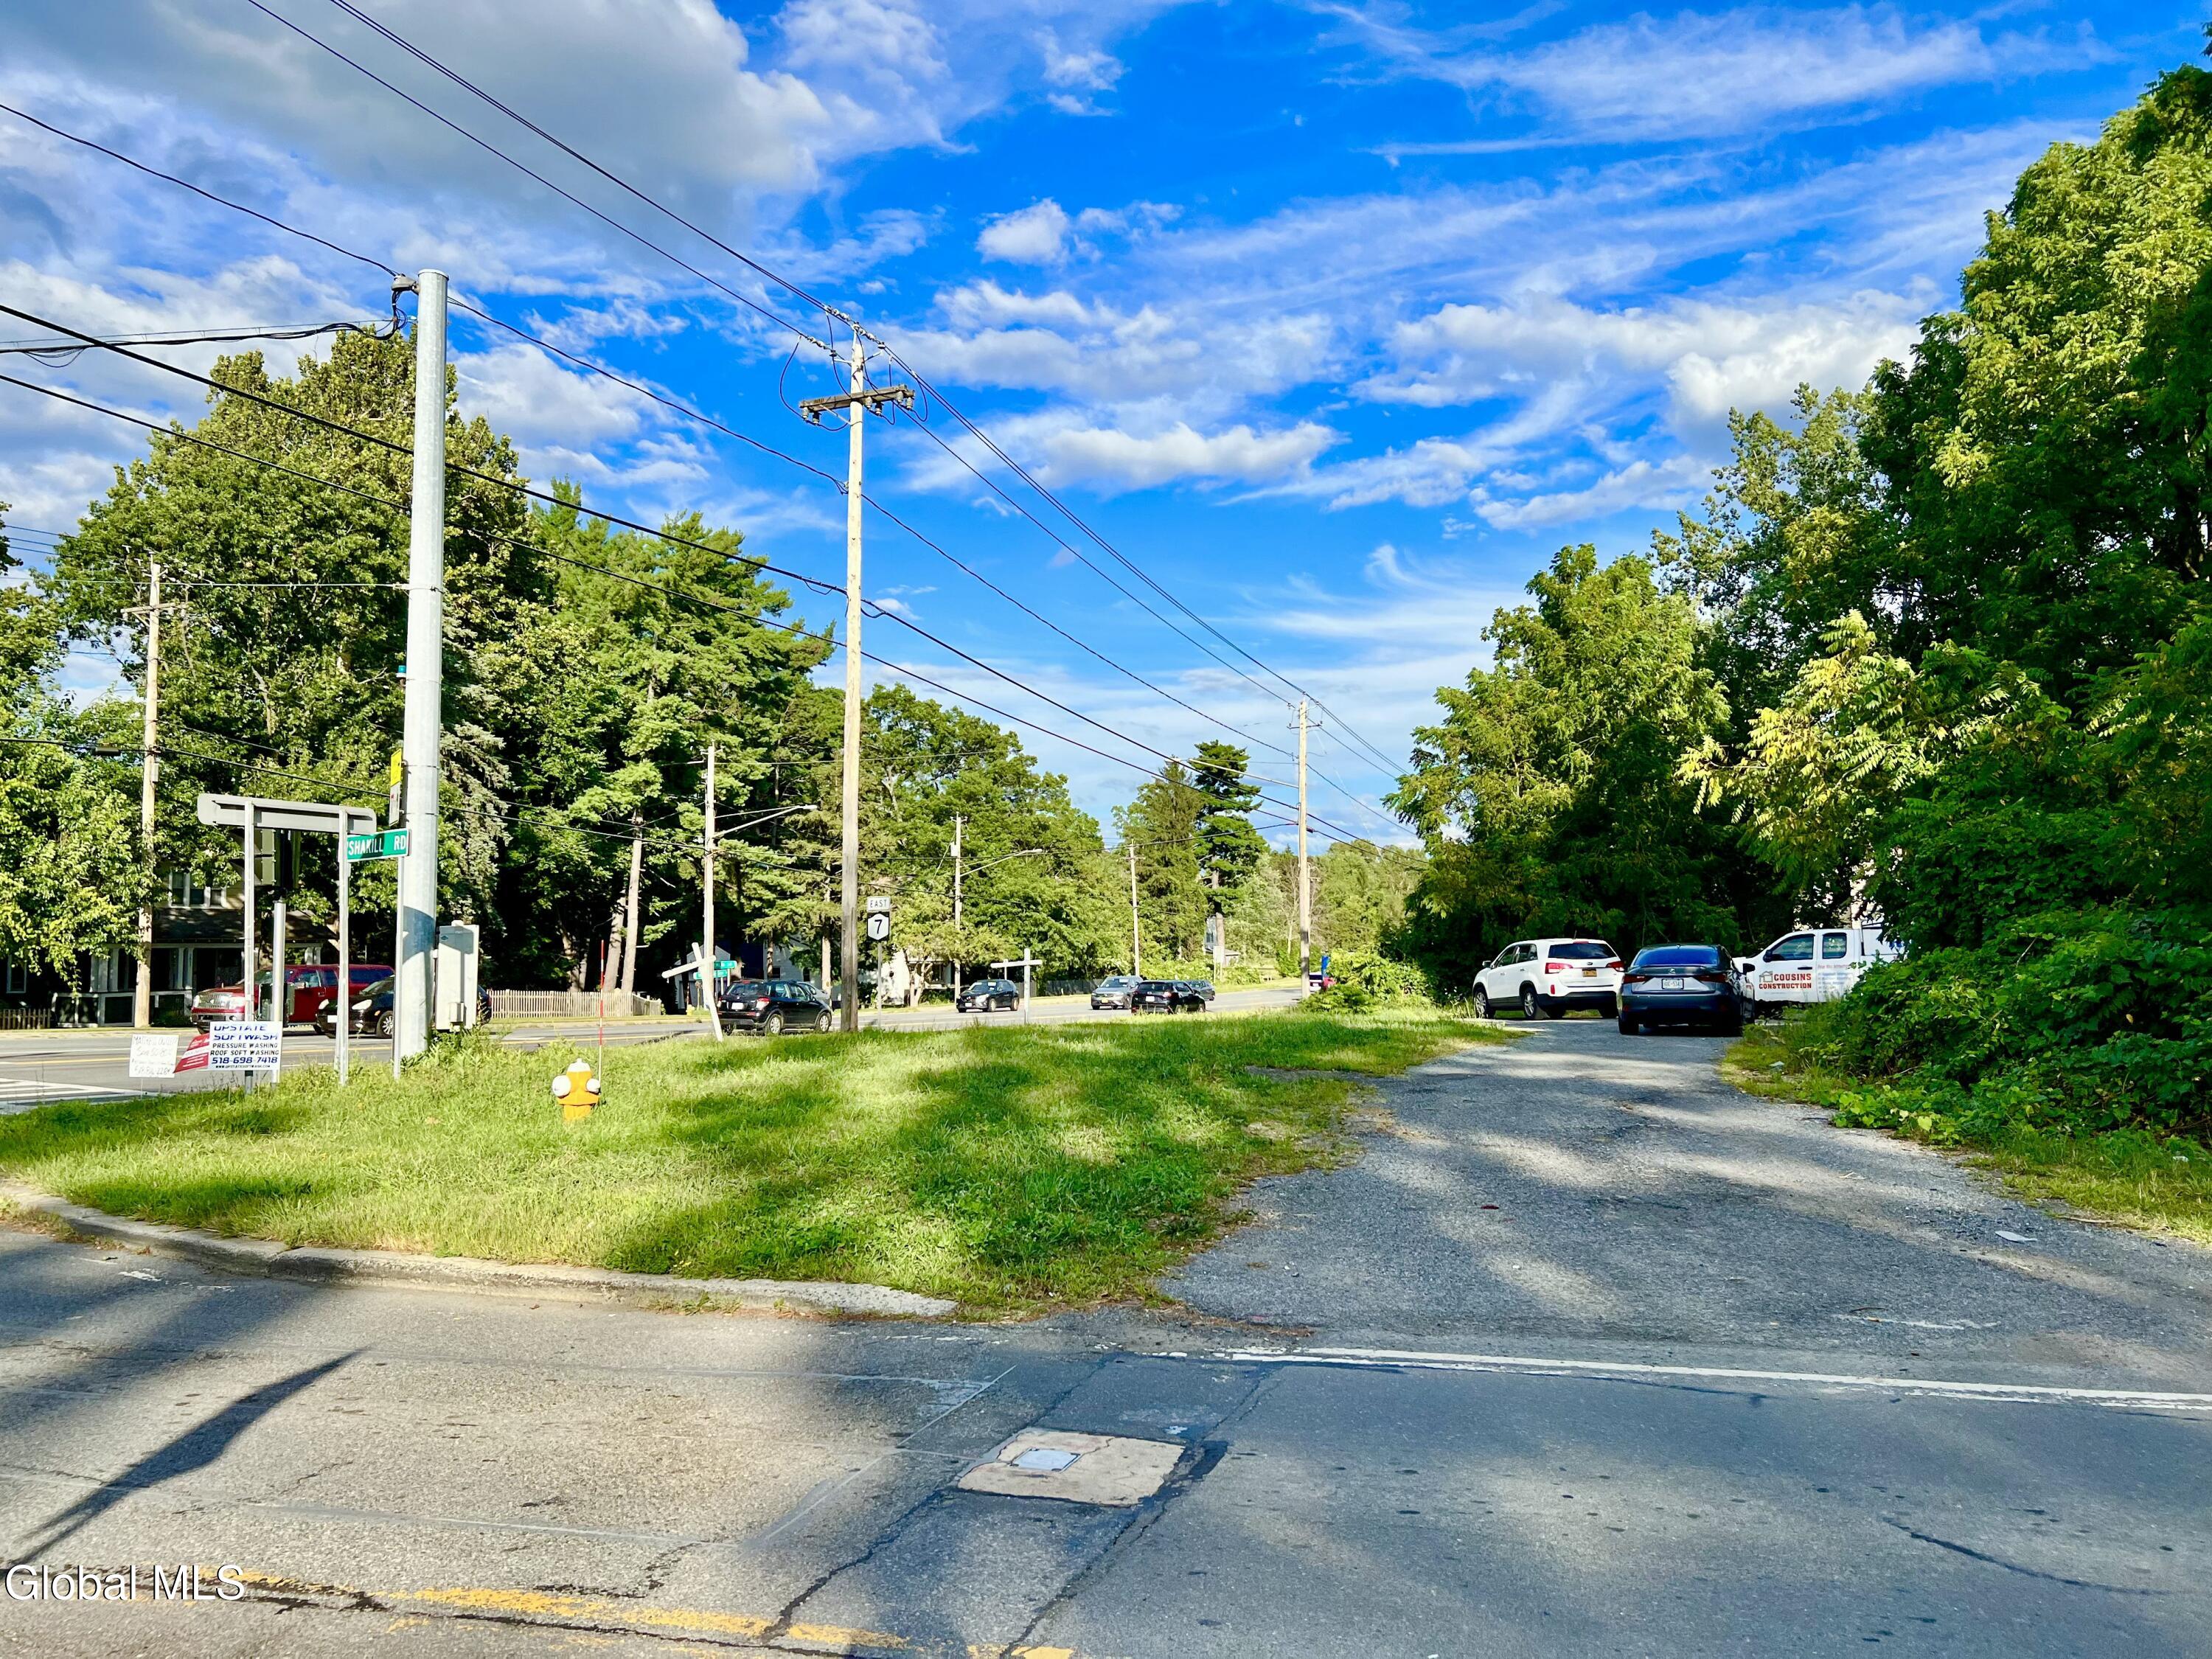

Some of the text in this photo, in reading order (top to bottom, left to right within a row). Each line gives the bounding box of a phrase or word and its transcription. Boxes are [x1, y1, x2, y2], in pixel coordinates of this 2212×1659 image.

[347, 835, 406, 855] SHAKILL RD
[870, 900, 887, 908] EAST
[874, 919, 883, 934] 7
[1774, 973, 1812, 981] COUSINS
